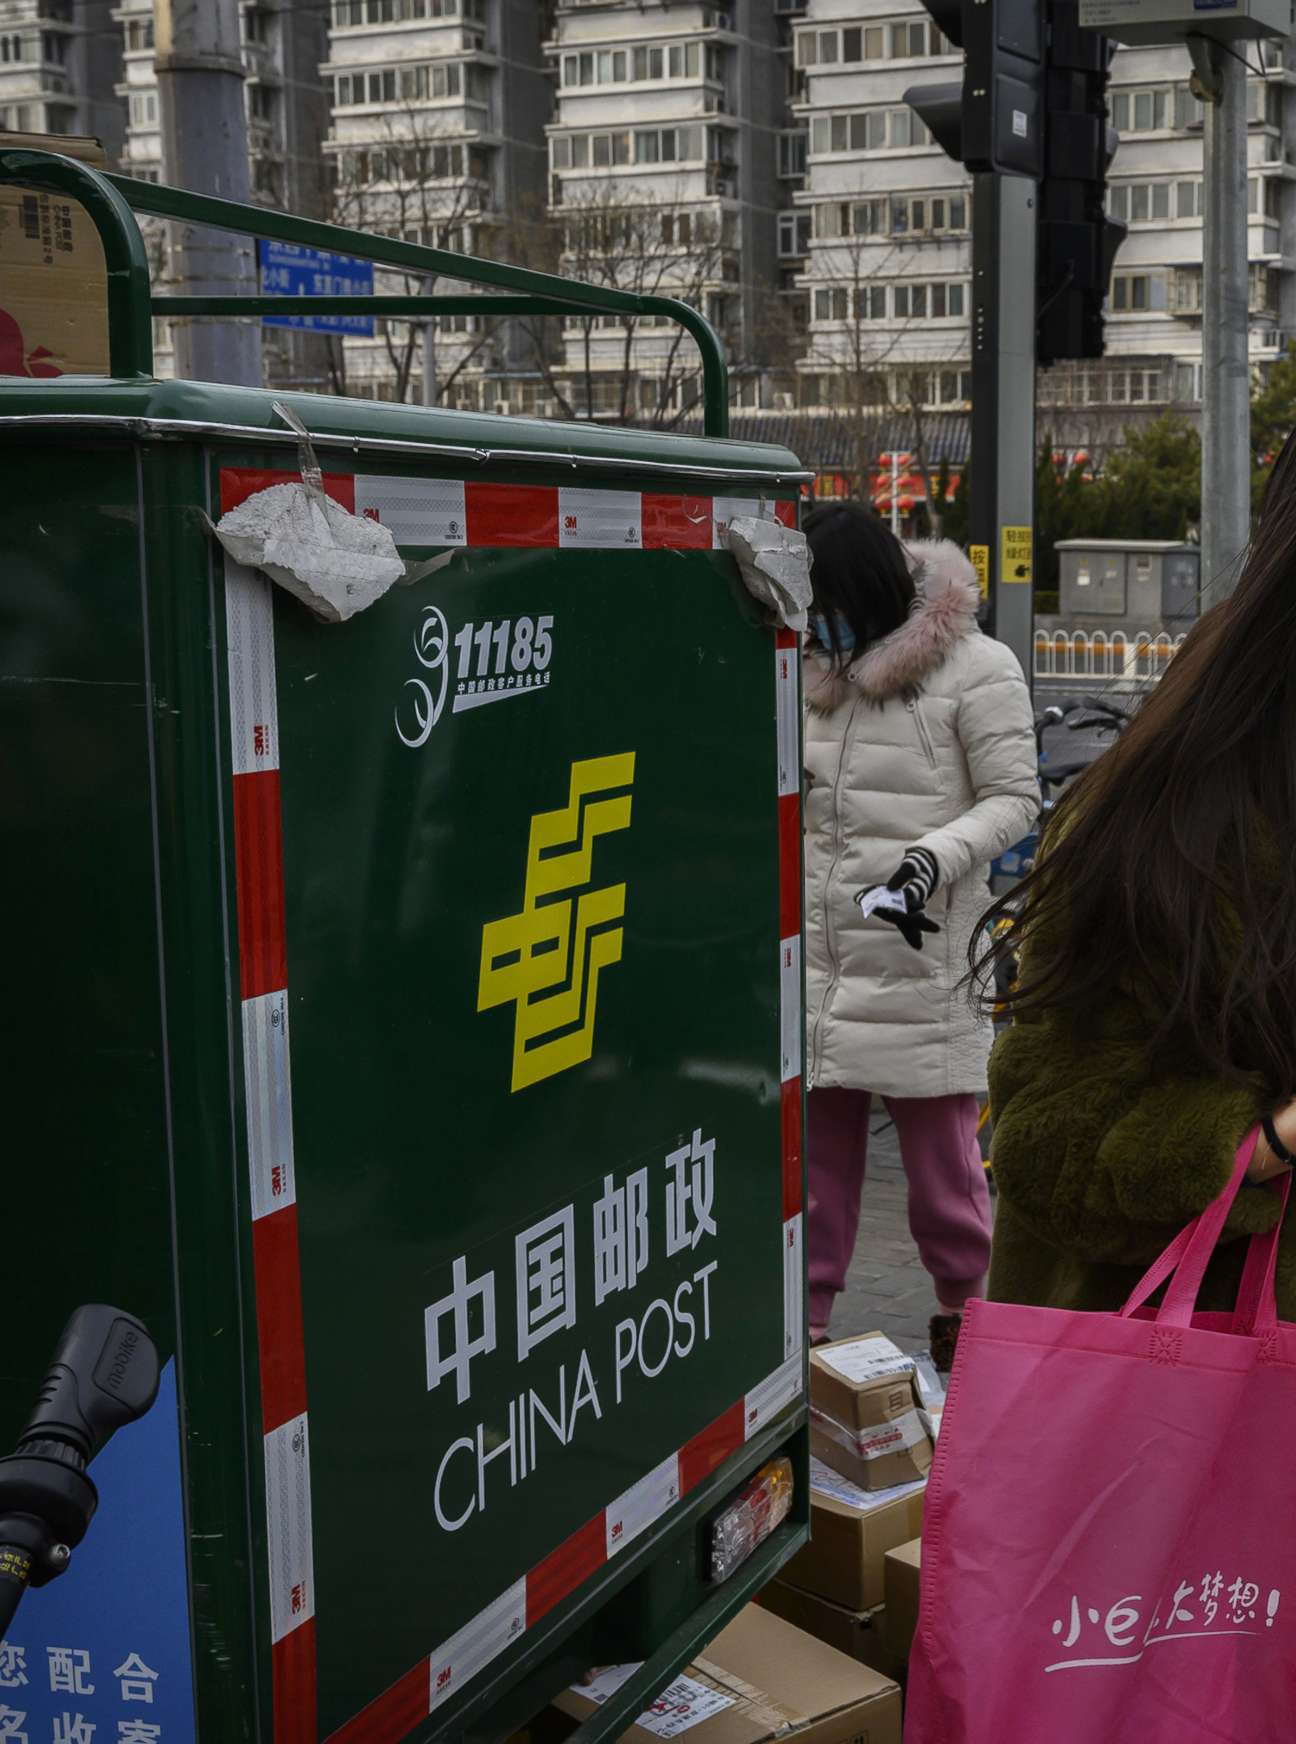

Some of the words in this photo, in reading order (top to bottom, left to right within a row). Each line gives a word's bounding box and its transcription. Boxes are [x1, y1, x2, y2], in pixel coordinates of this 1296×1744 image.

[565, 516, 577, 529] 3M
[455, 615, 554, 679] 11185
[254, 725, 265, 757] 3M
[271, 1165, 282, 1198] 3M
[424, 1128, 717, 1405] 中国邮政
[109, 1331, 139, 1390] mobike
[434, 1348, 602, 1531] CHINA
[615, 1260, 718, 1404] POST
[611, 1520, 623, 1538] 3M
[291, 1583, 302, 1615] 3M
[0, 1640, 159, 1704] 您配合
[436, 1665, 452, 1689] 3M
